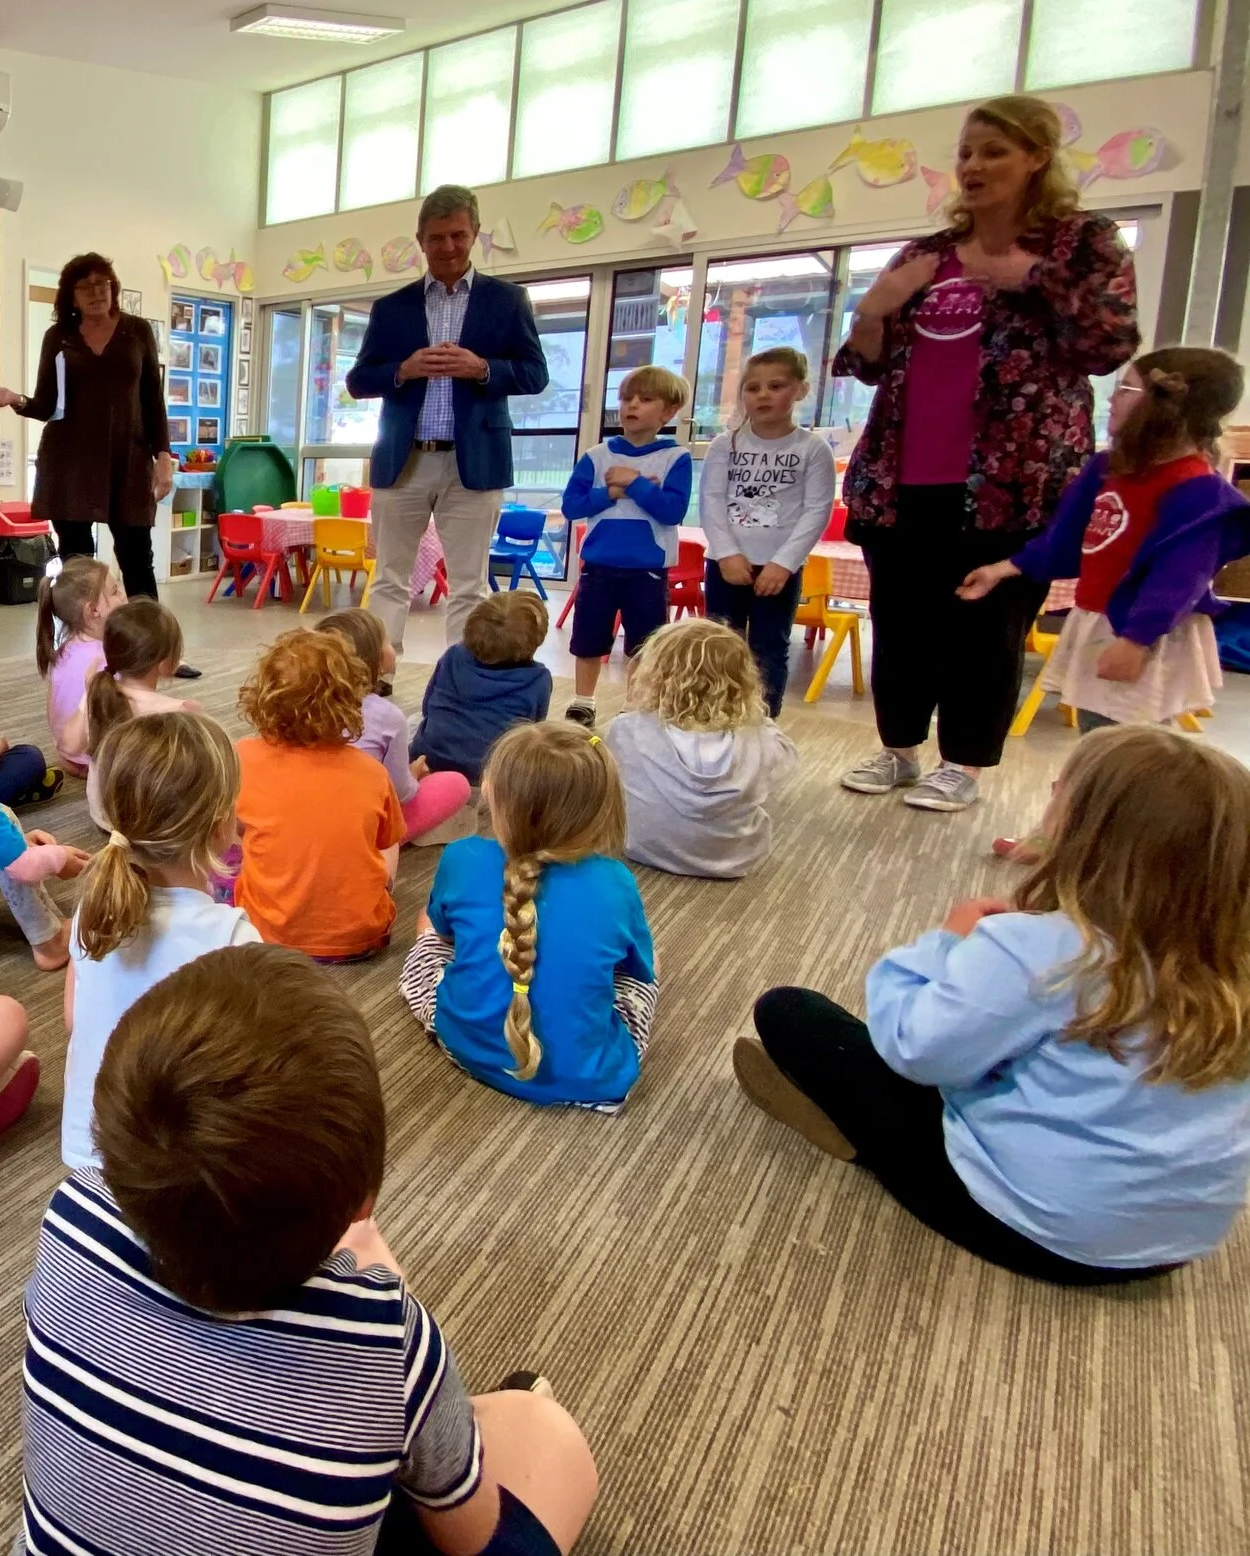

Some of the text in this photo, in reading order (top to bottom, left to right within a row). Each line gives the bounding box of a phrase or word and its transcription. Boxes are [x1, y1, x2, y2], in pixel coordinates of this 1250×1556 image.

[760, 453, 768, 466] A
[774, 454, 800, 467] KID
[754, 469, 797, 484] LOVES
